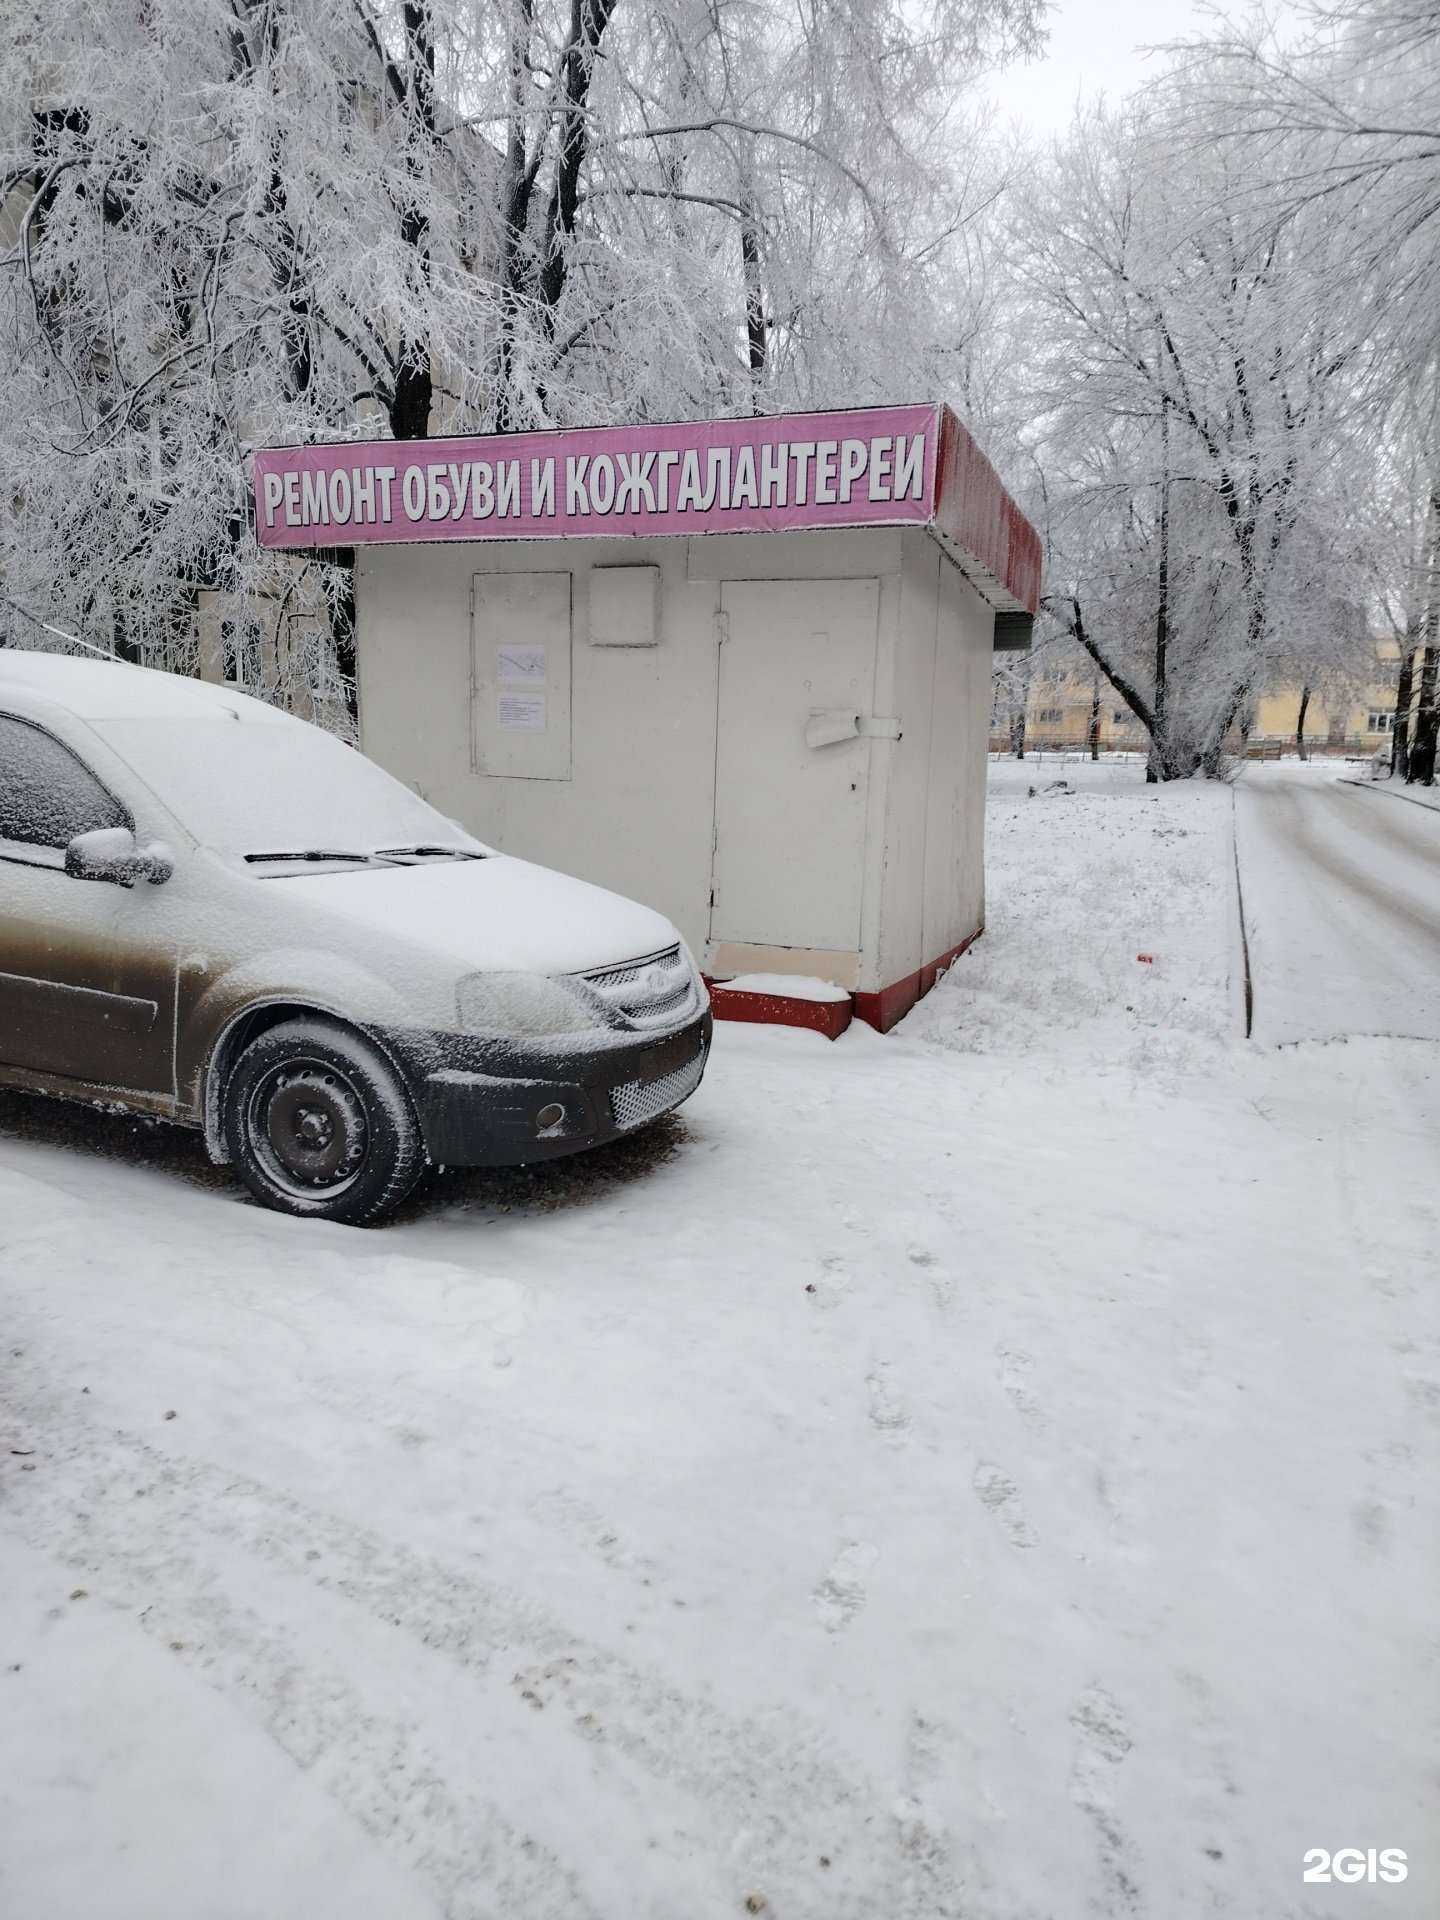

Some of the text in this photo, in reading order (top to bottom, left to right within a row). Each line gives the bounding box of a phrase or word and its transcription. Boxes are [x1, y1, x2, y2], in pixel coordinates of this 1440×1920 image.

[263, 434, 925, 527] РЕМОНТ ОБУВИ И КОЖГАЛАНТЕРЕИ
